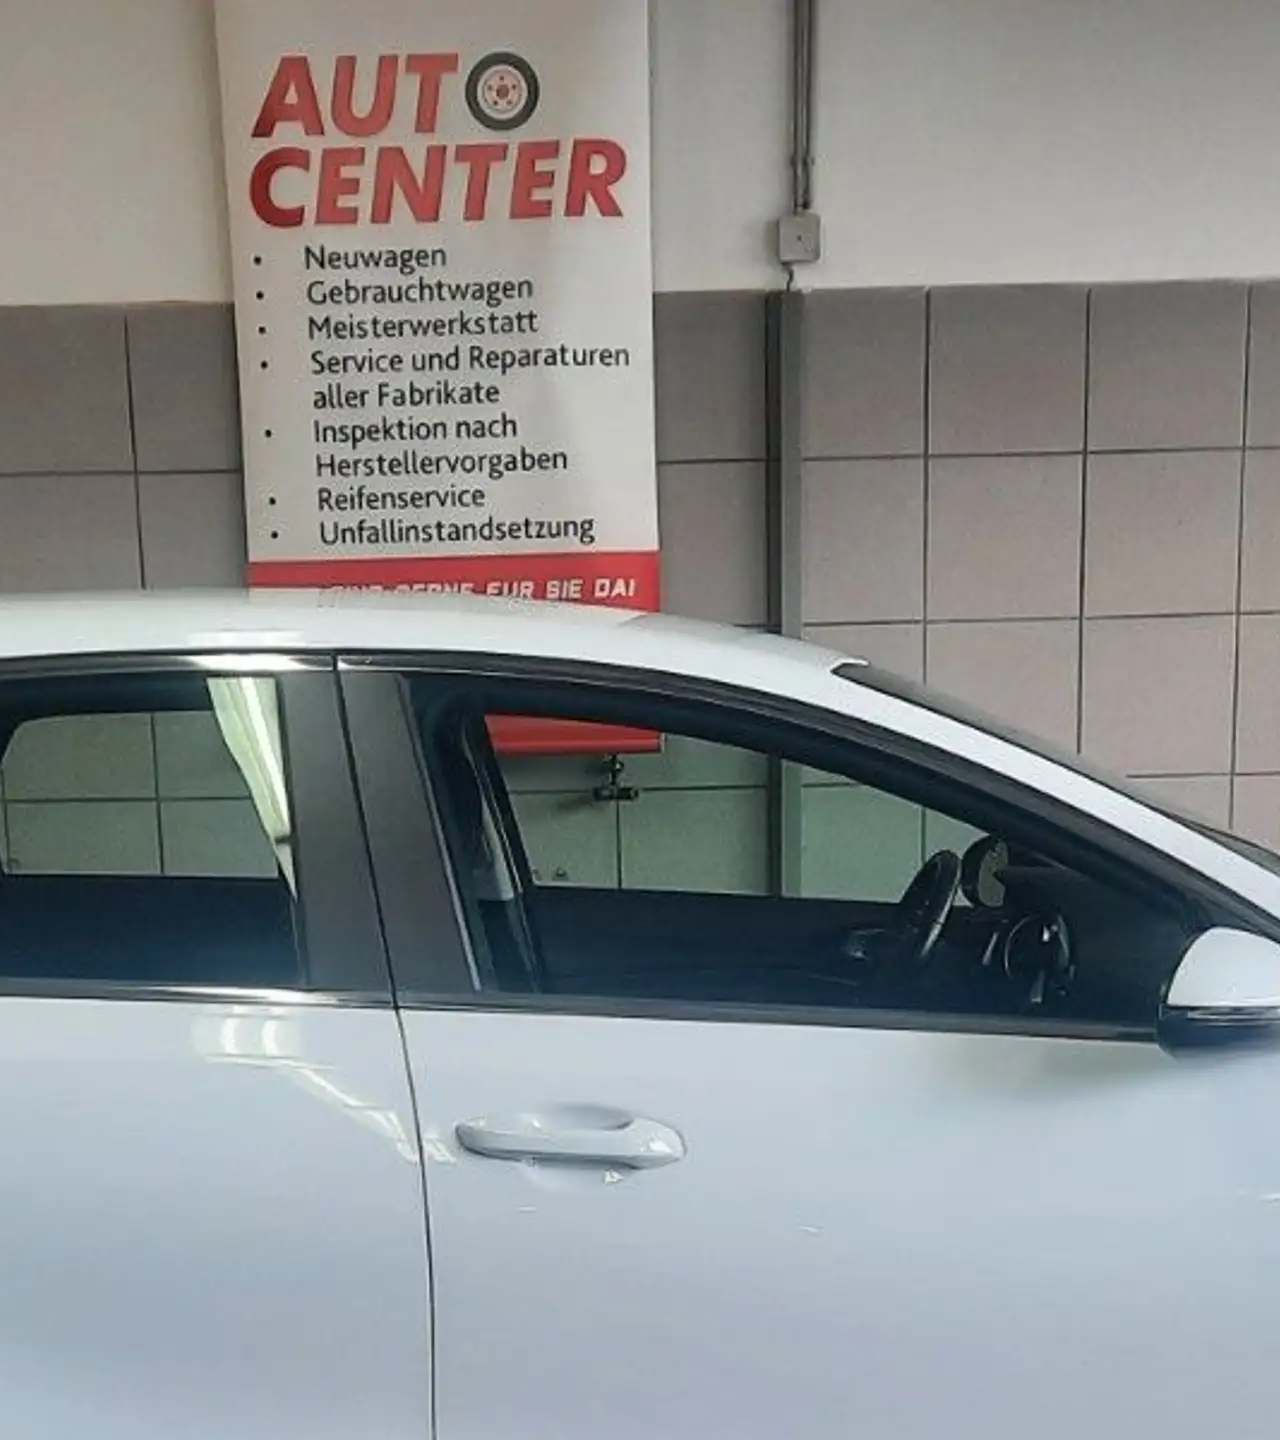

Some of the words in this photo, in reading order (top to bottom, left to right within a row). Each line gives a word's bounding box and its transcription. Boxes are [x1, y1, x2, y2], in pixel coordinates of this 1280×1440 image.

[248, 138, 627, 229] CENTER
[304, 244, 447, 275] Neuwagen
[306, 276, 534, 308] Gebrauchtwagen
[308, 309, 539, 340] Meisterwerkstatt
[310, 348, 404, 375] Service
[411, 346, 460, 371] und
[469, 344, 630, 374] Reparaturen
[313, 382, 370, 410] aller
[377, 380, 501, 407] Fabrikate
[314, 416, 449, 449] Inspektion
[455, 412, 518, 440] nach
[316, 447, 569, 480] Herstellervorgaben
[318, 487, 486, 511] Reifenservice
[320, 517, 596, 545] Unfallinstandsetzung
[546, 579, 584, 599] SIE
